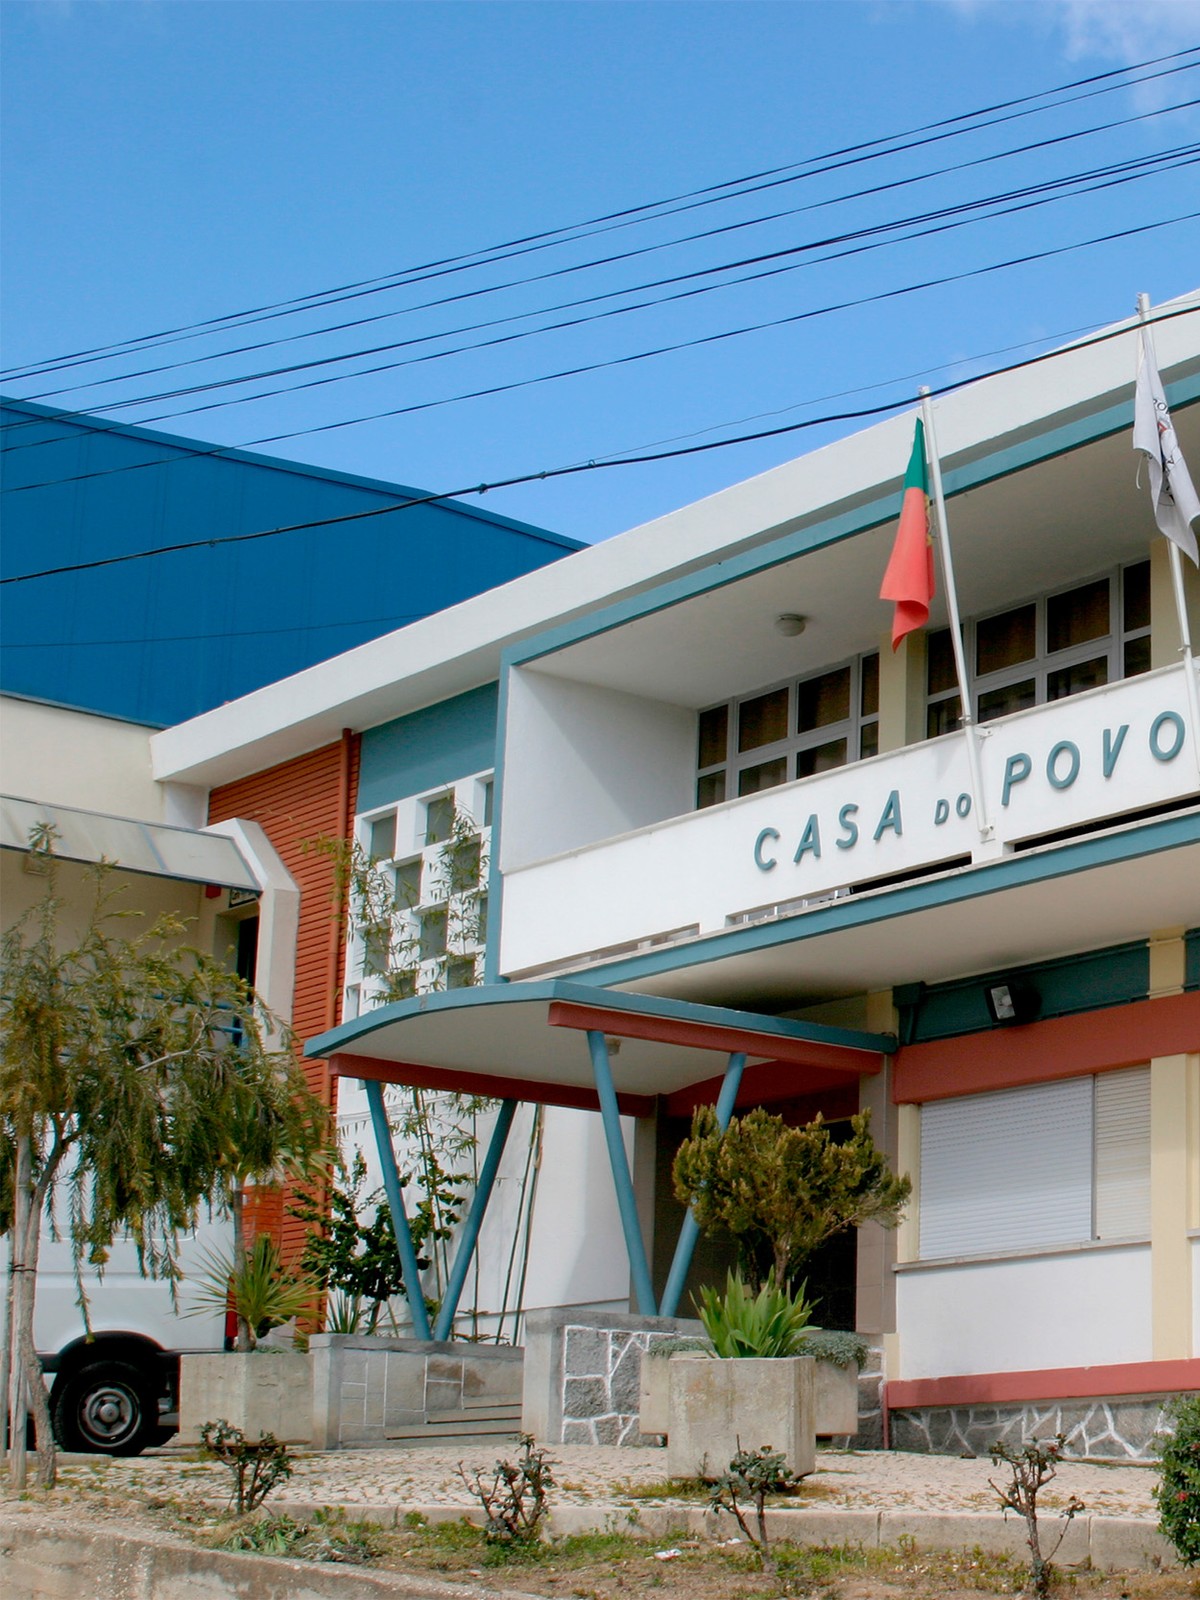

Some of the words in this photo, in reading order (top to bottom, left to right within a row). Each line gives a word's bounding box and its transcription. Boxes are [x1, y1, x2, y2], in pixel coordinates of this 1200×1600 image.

[755, 793, 901, 871] CASA
[935, 800, 971, 824] DO
[1002, 711, 1184, 806] POVO
